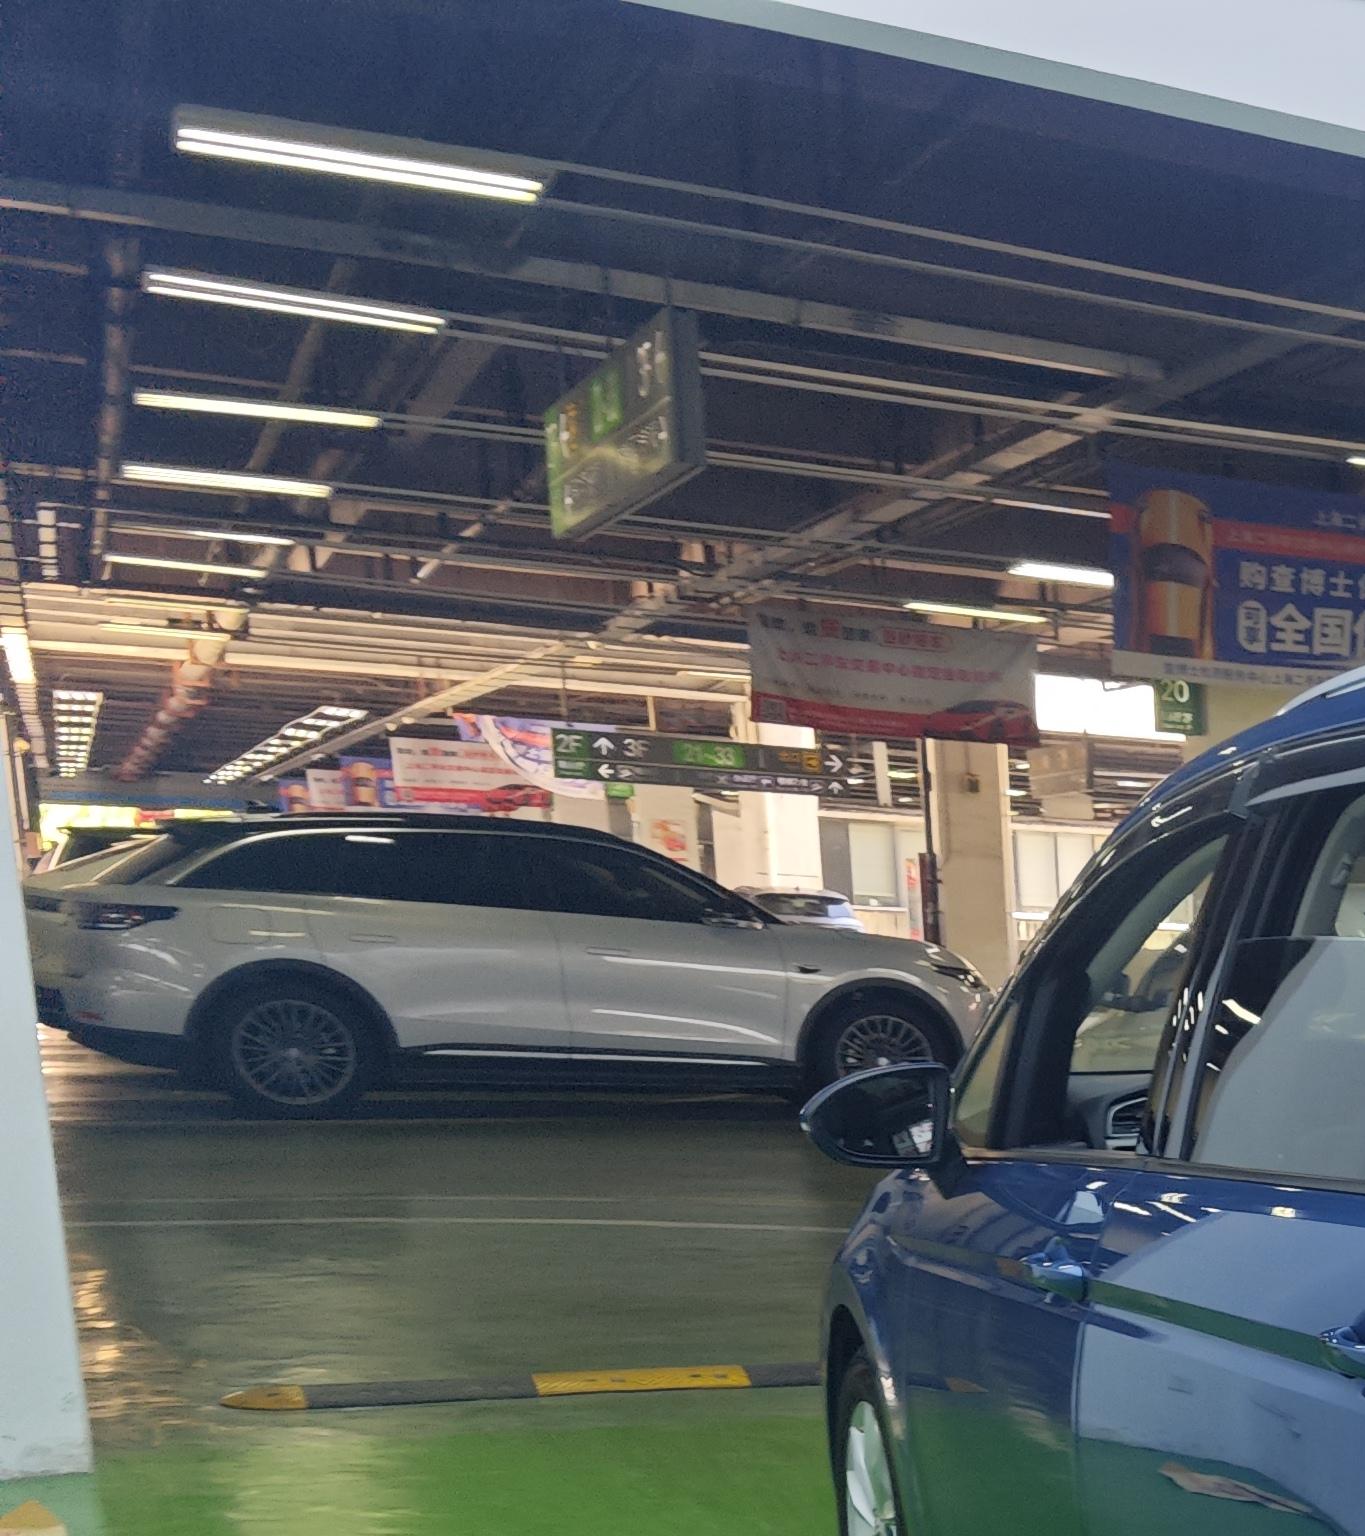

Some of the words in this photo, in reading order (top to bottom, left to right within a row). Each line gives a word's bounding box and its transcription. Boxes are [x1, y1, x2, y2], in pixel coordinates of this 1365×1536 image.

[1160, 680, 1190, 703] 20
[555, 734, 583, 754] 2F
[622, 738, 649, 758] 3F
